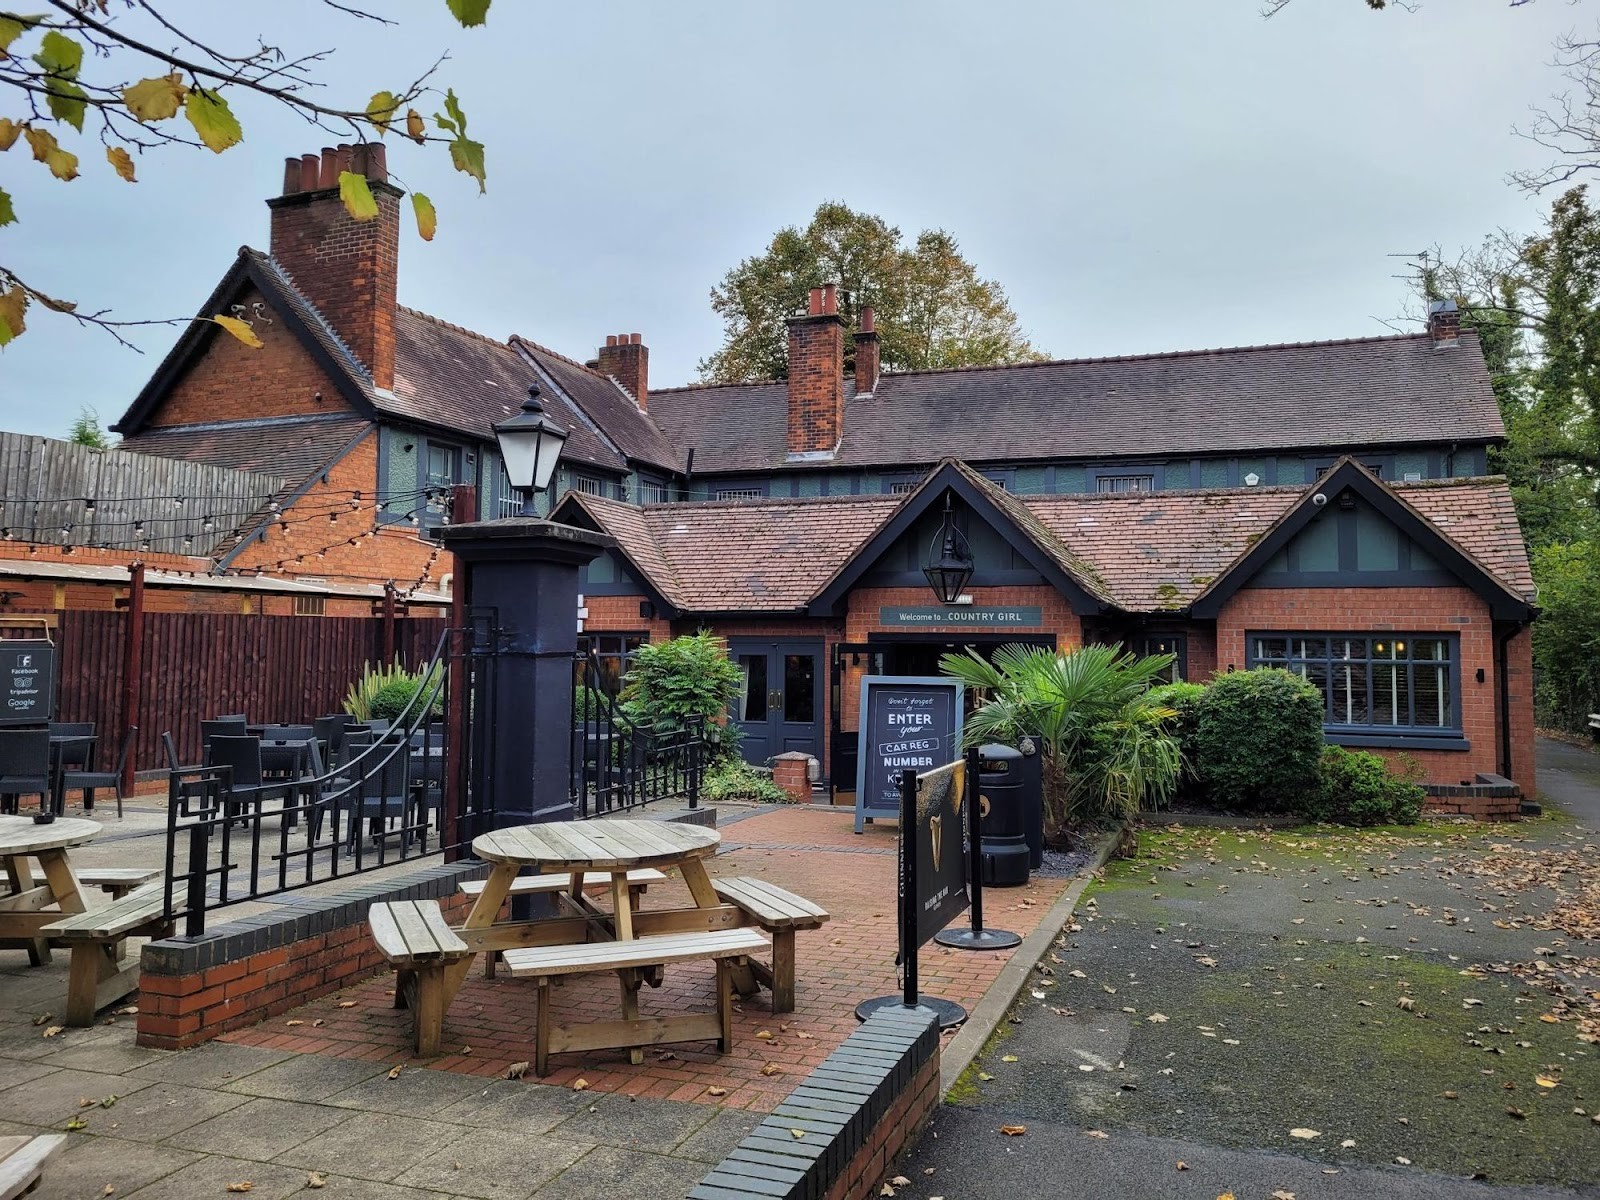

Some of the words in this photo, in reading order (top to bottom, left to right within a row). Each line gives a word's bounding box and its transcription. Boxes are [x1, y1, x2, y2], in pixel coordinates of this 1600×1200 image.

[948, 612, 994, 621] COUNTRY
[998, 612, 1022, 621] GIRL
[8, 699, 35, 707] Google
[910, 698, 934, 706] forget
[888, 714, 932, 725] ENTER
[898, 726, 923, 738] your
[886, 744, 907, 753] CAR
[910, 741, 929, 750] REG
[884, 757, 933, 767] NUMBER
